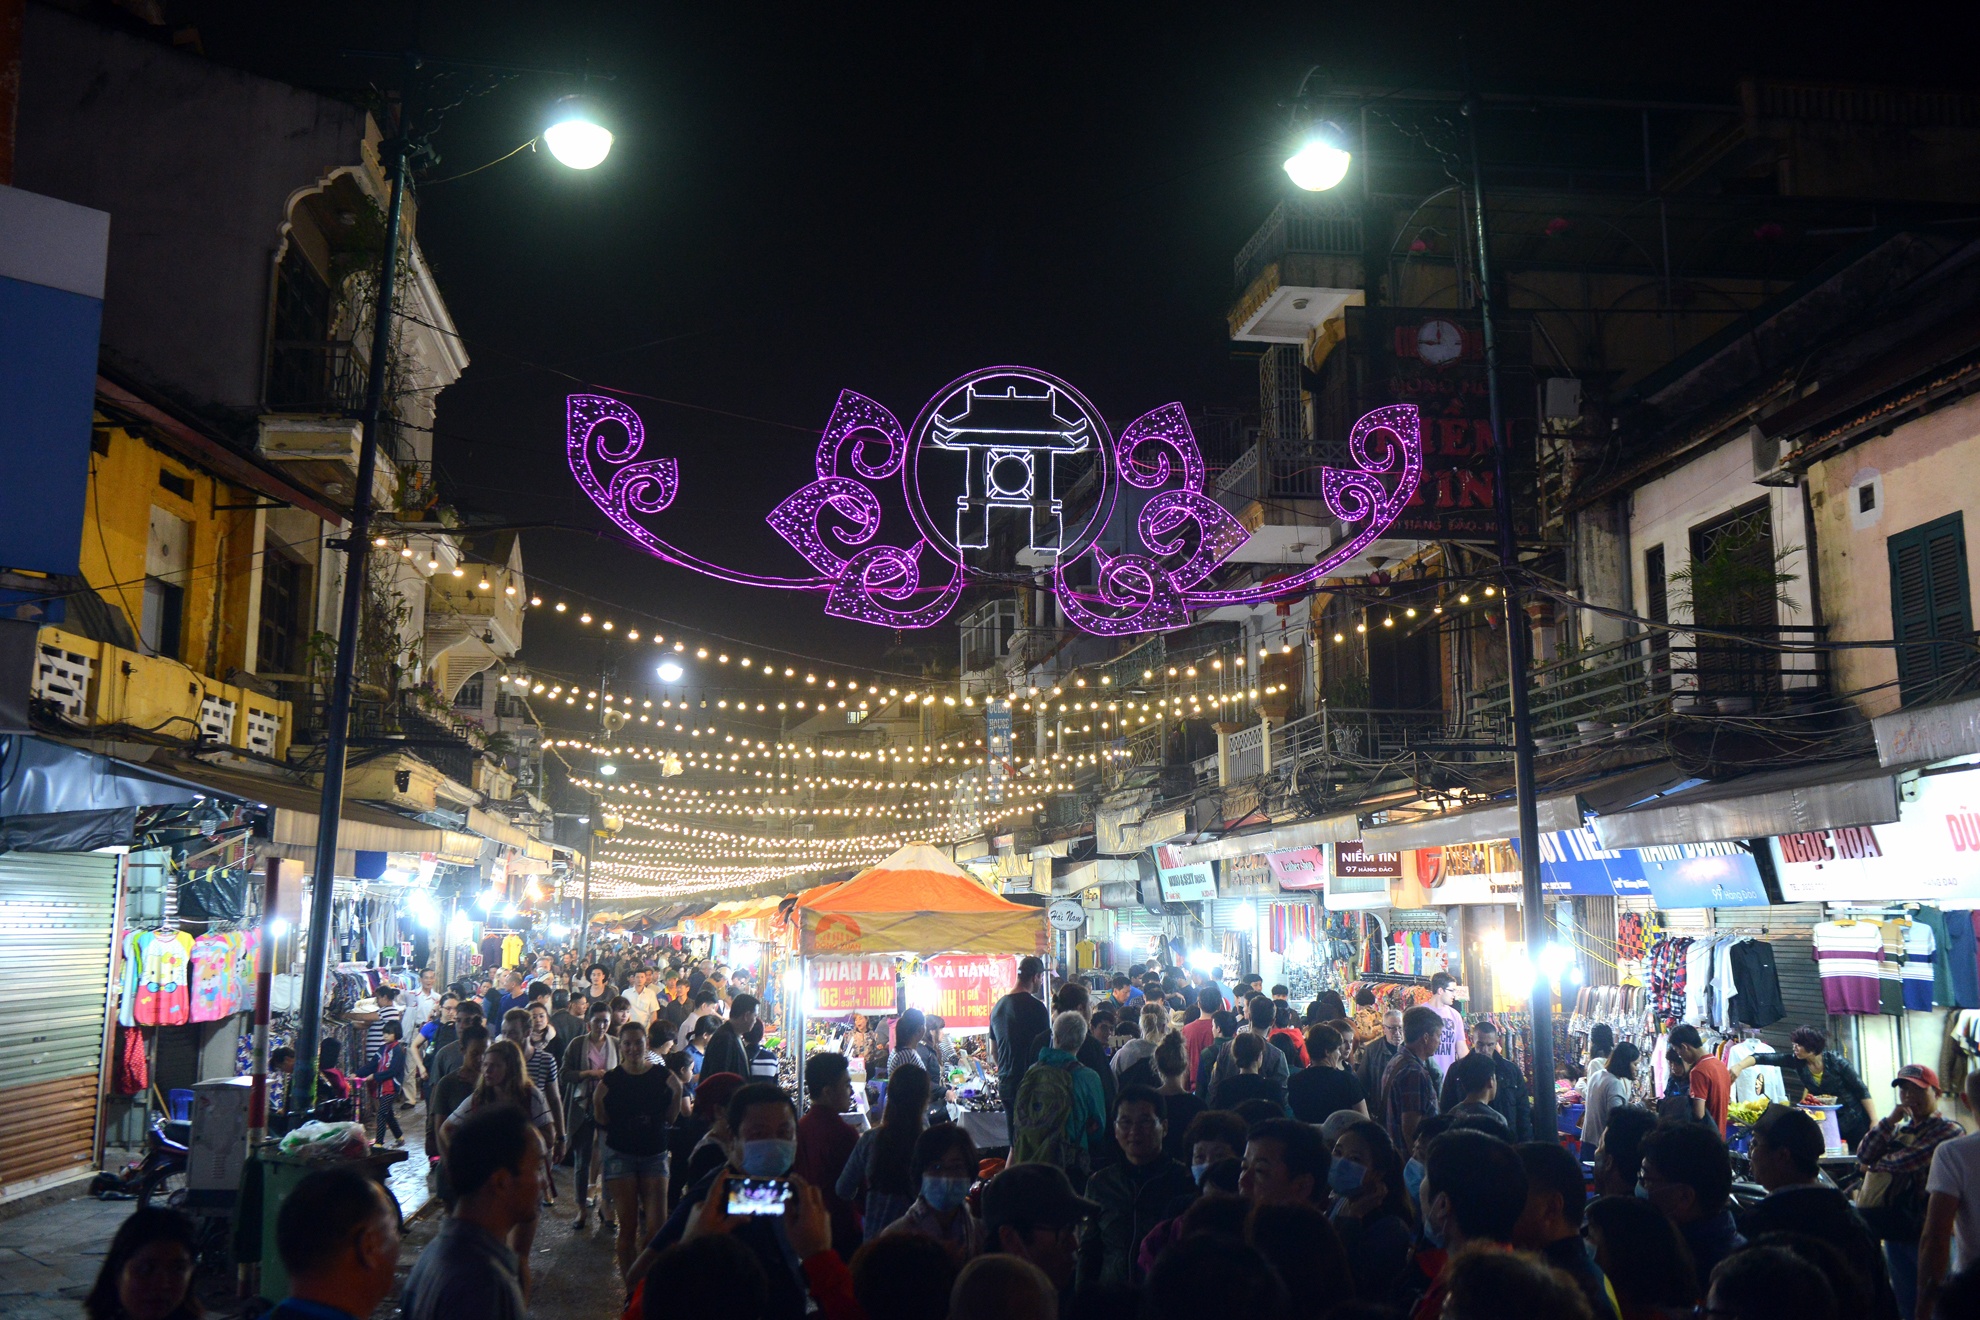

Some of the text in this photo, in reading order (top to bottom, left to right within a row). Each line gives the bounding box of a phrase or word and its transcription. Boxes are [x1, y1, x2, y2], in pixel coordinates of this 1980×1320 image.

[1945, 806, 1980, 852] DŨ
[1378, 852, 1397, 863] TIN
[470, 956, 481, 966] 50
[933, 960, 999, 978] XẢ HÀNG
[967, 1005, 987, 1017] PRICE
